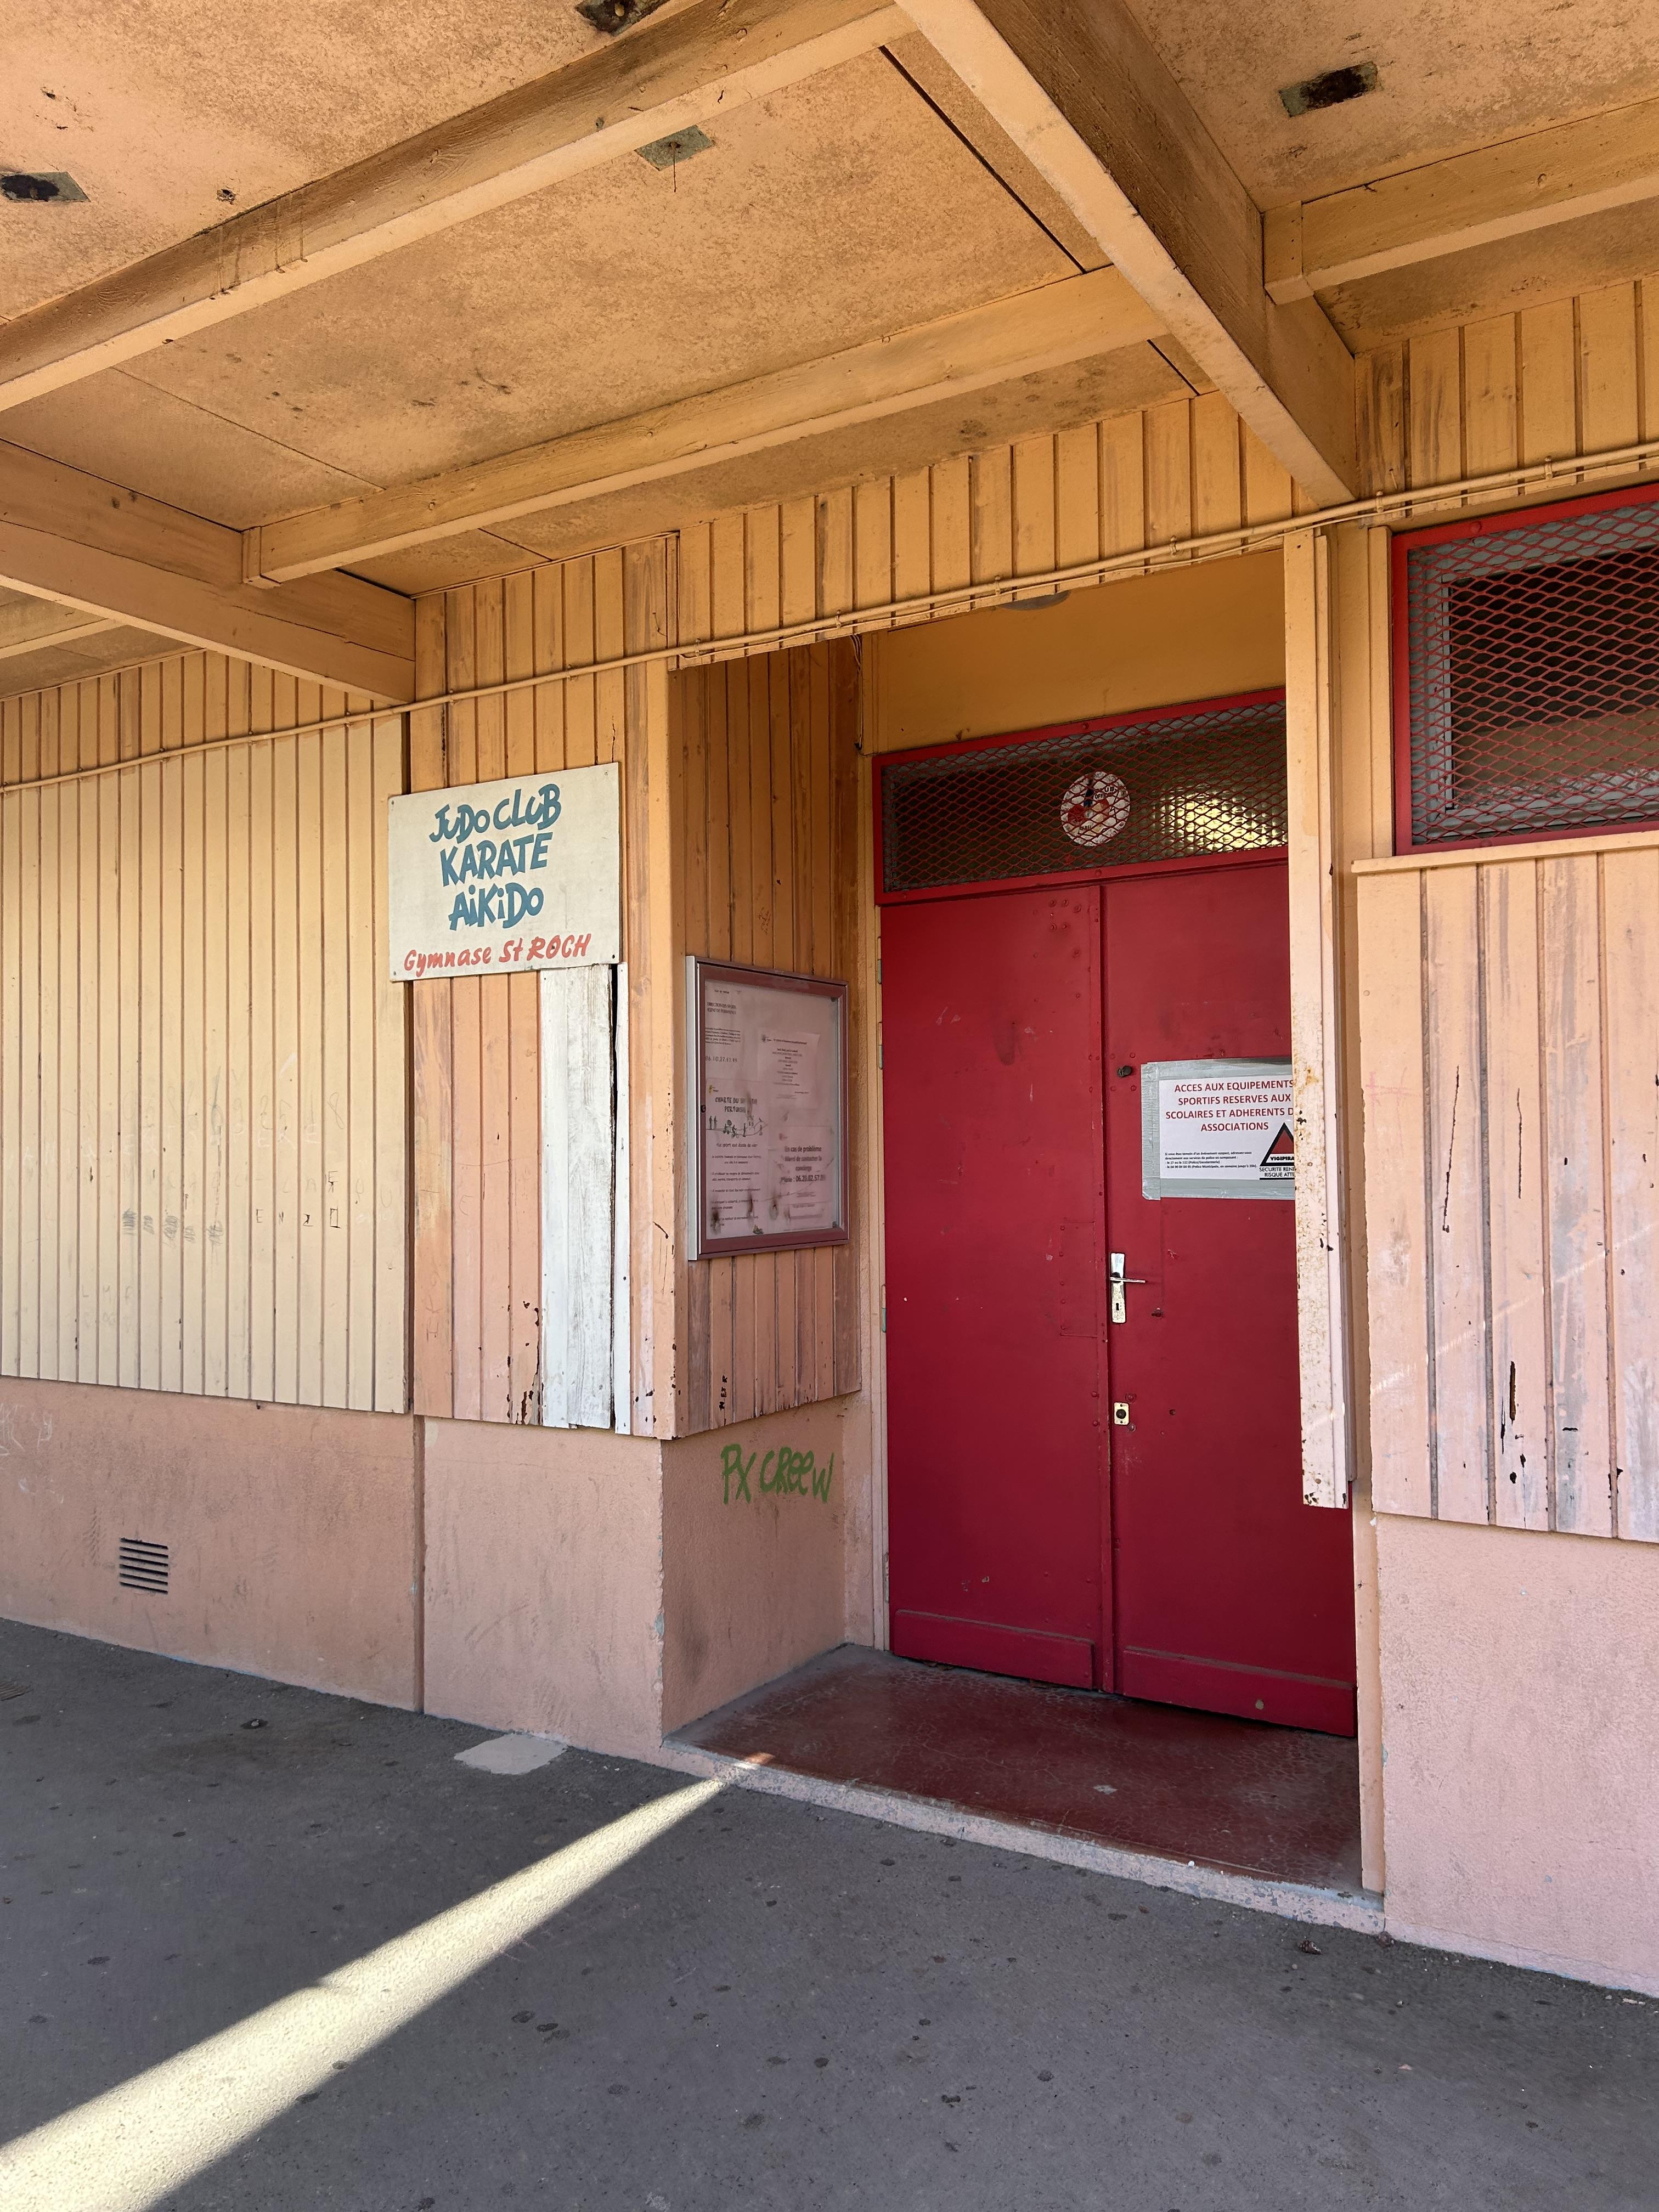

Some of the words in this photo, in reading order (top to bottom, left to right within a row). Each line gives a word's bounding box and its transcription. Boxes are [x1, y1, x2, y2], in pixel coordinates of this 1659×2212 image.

[439, 832, 553, 887] KARATE
[403, 946, 492, 977] Gymnase
[526, 933, 592, 962] ROCH
[1174, 1084, 1203, 1092] ACCES
[1205, 1082, 1224, 1091] AUX
[1227, 1080, 1294, 1091] EQUIPEMENTS
[1178, 1096, 1221, 1105] SPORTIFS
[1223, 1095, 1268, 1104] RESERVES
[1271, 1094, 1291, 1103] AUX
[1165, 1109, 1214, 1119] SCOLAIRES
[1216, 1109, 1227, 1118] ET
[1228, 1108, 1285, 1118] ADHERENTS
[1200, 1122, 1269, 1132] ASSOCIATIONS
